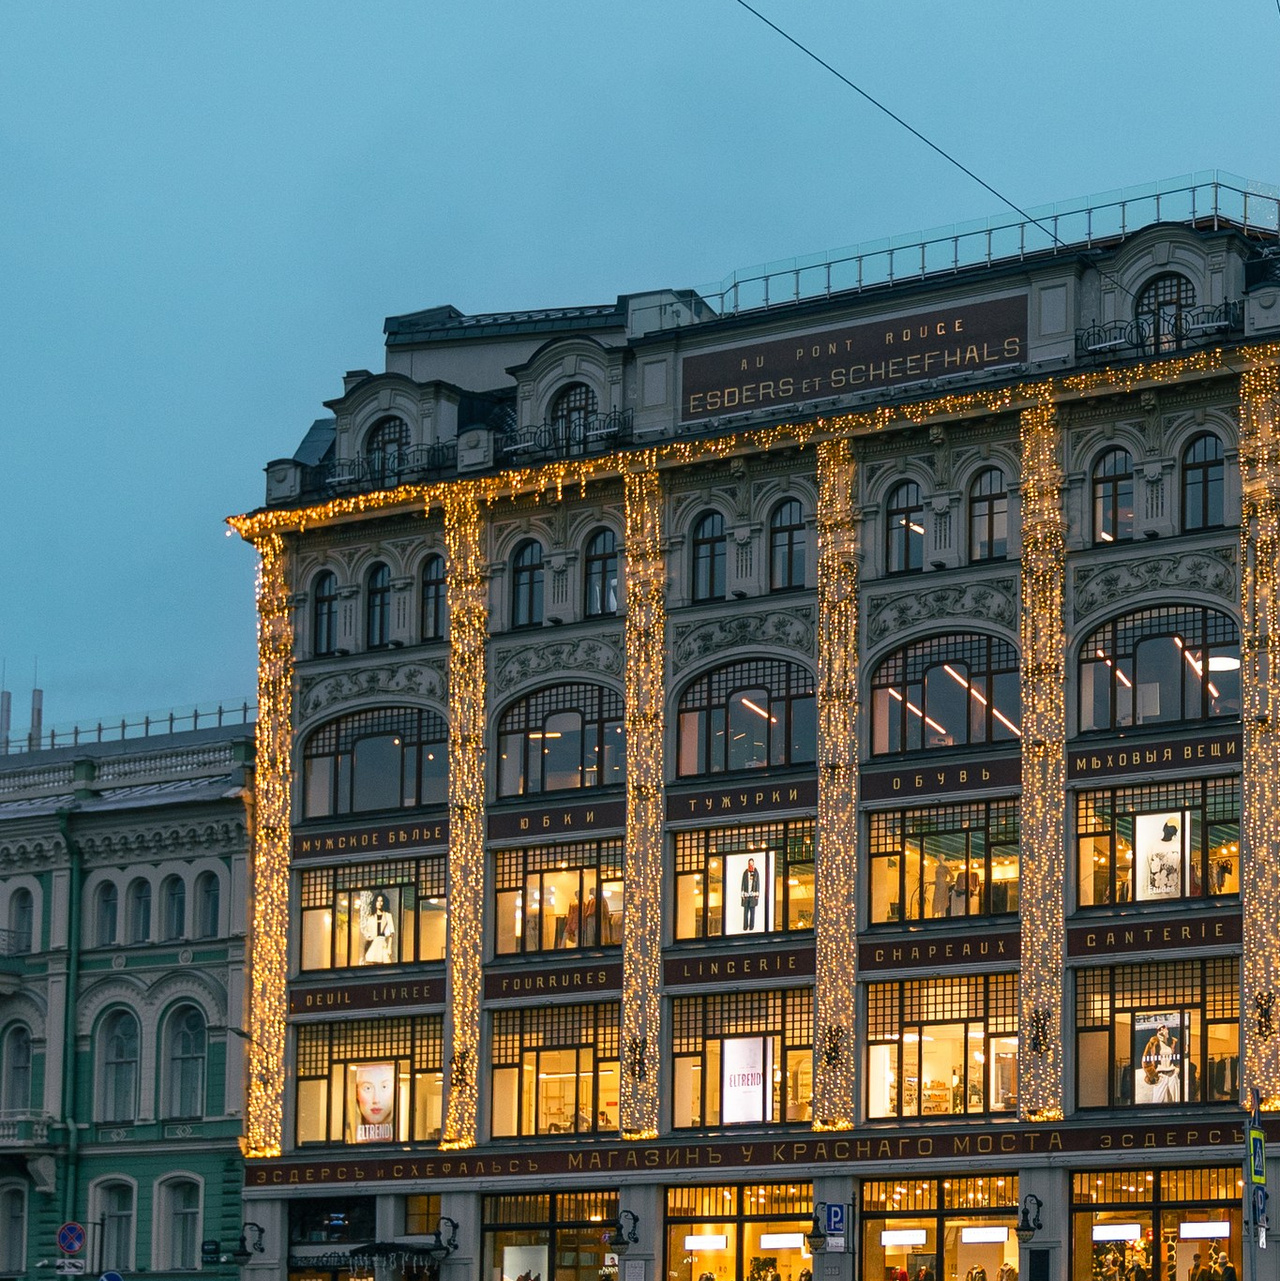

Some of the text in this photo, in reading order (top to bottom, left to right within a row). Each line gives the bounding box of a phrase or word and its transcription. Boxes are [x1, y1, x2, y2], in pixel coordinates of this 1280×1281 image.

[740, 319, 964, 371] AU PONT ROUGE
[689, 336, 1021, 414] ESDERS ET SCHEEFHALS
[1183, 741, 1236, 759] ВЕЩИ
[892, 768, 990, 790] ОБУВЬ
[688, 789, 798, 812] ТУЖУРКИ
[519, 811, 595, 830] ЮБКИ
[302, 833, 379, 852] МУЖСКОЕ
[875, 940, 1005, 962] CHAPEAUX
[683, 955, 796, 977] LINGERIE
[502, 971, 607, 991] FOURRURES
[306, 985, 431, 1007] DEUIL LIVREE
[256, 1166, 365, 1184] ЭСДЕРСЪ
[392, 1159, 539, 1177] СХЕФАЛЬСЪ
[568, 1146, 723, 1170] МАГАЗИНЪ
[742, 1145, 754, 1163] У
[772, 1137, 933, 1161] КРАСНАГО
[953, 1131, 1064, 1155] МОСТА
[1100, 1128, 1245, 1149] ЭСДЕРСЪ
[831, 1206, 841, 1230] P
